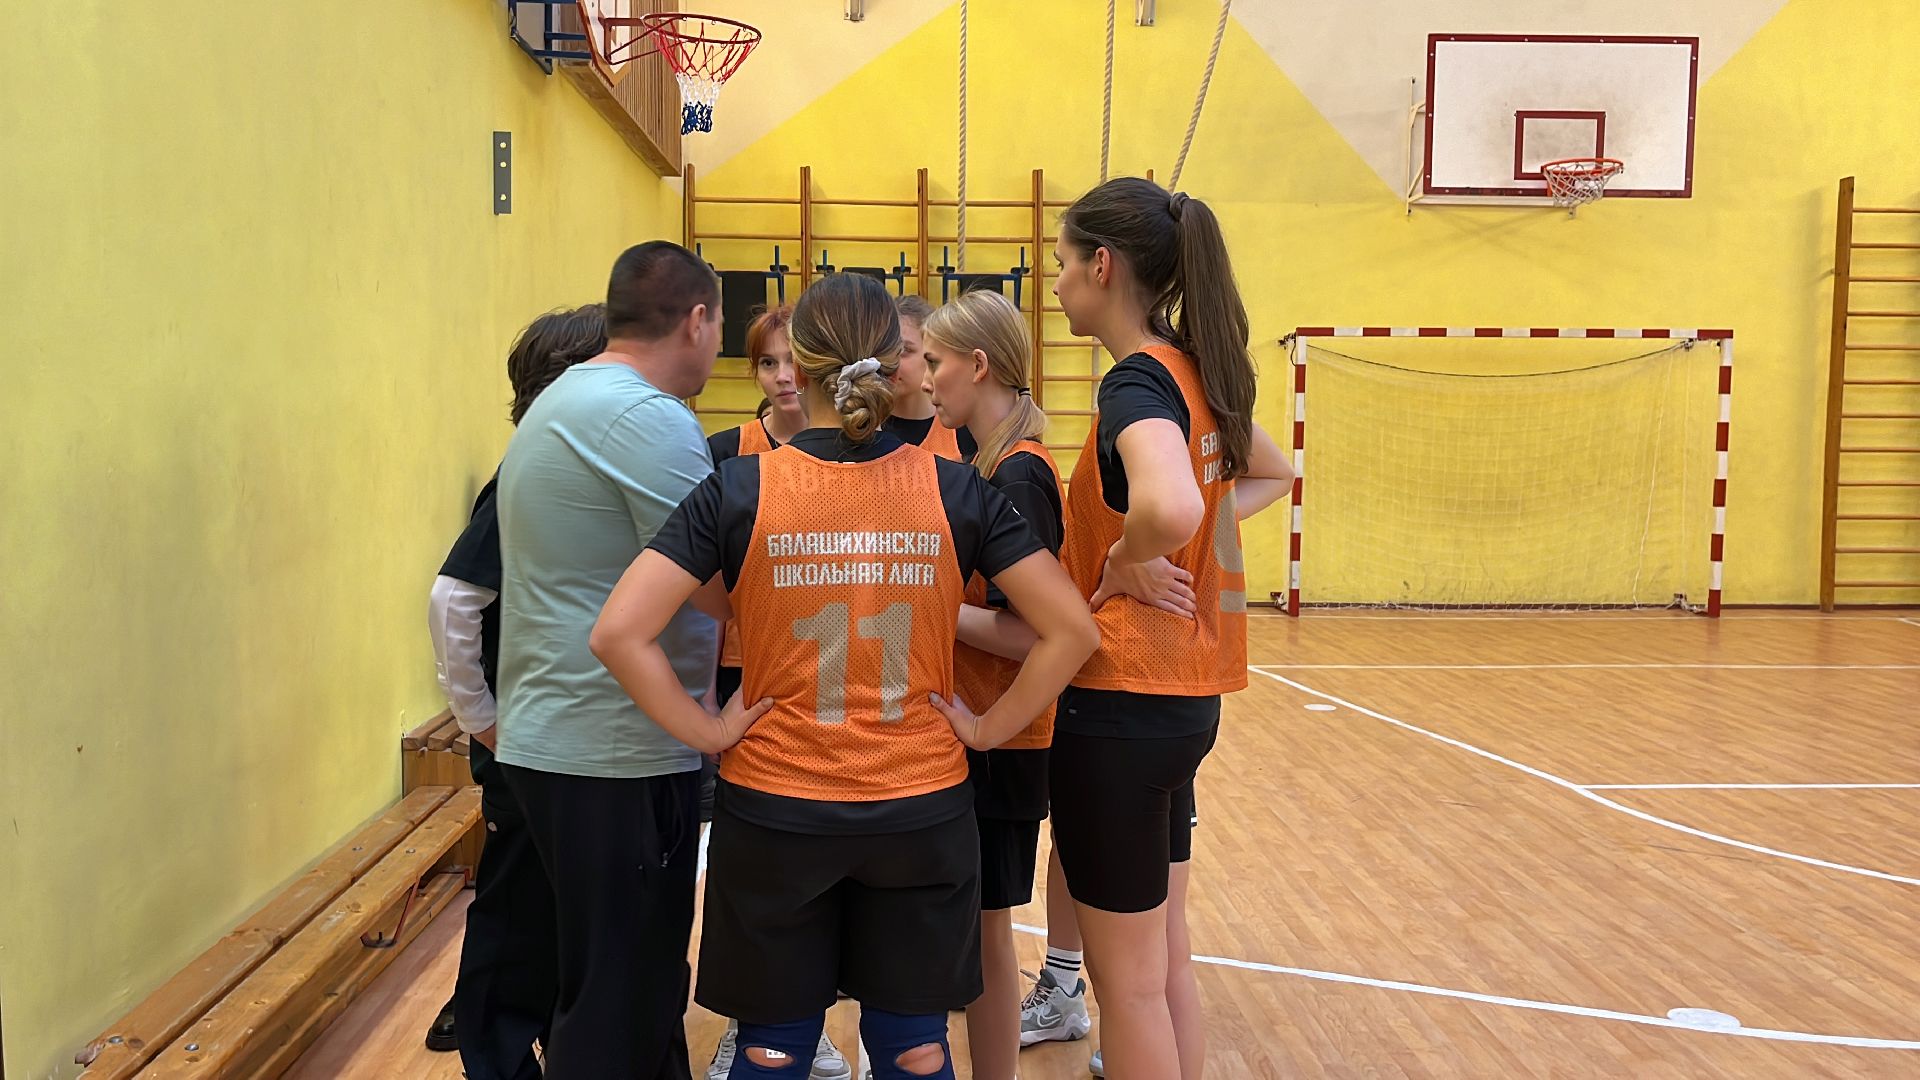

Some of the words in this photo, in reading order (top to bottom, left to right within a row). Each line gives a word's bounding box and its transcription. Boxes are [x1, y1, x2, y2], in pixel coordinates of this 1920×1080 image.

[767, 531, 941, 557] БАЛАШИХИНСКАЯ
[773, 562, 884, 588] ШКОЛЬНАЯ
[889, 562, 935, 586] ЛИГА
[792, 602, 912, 724] 11
